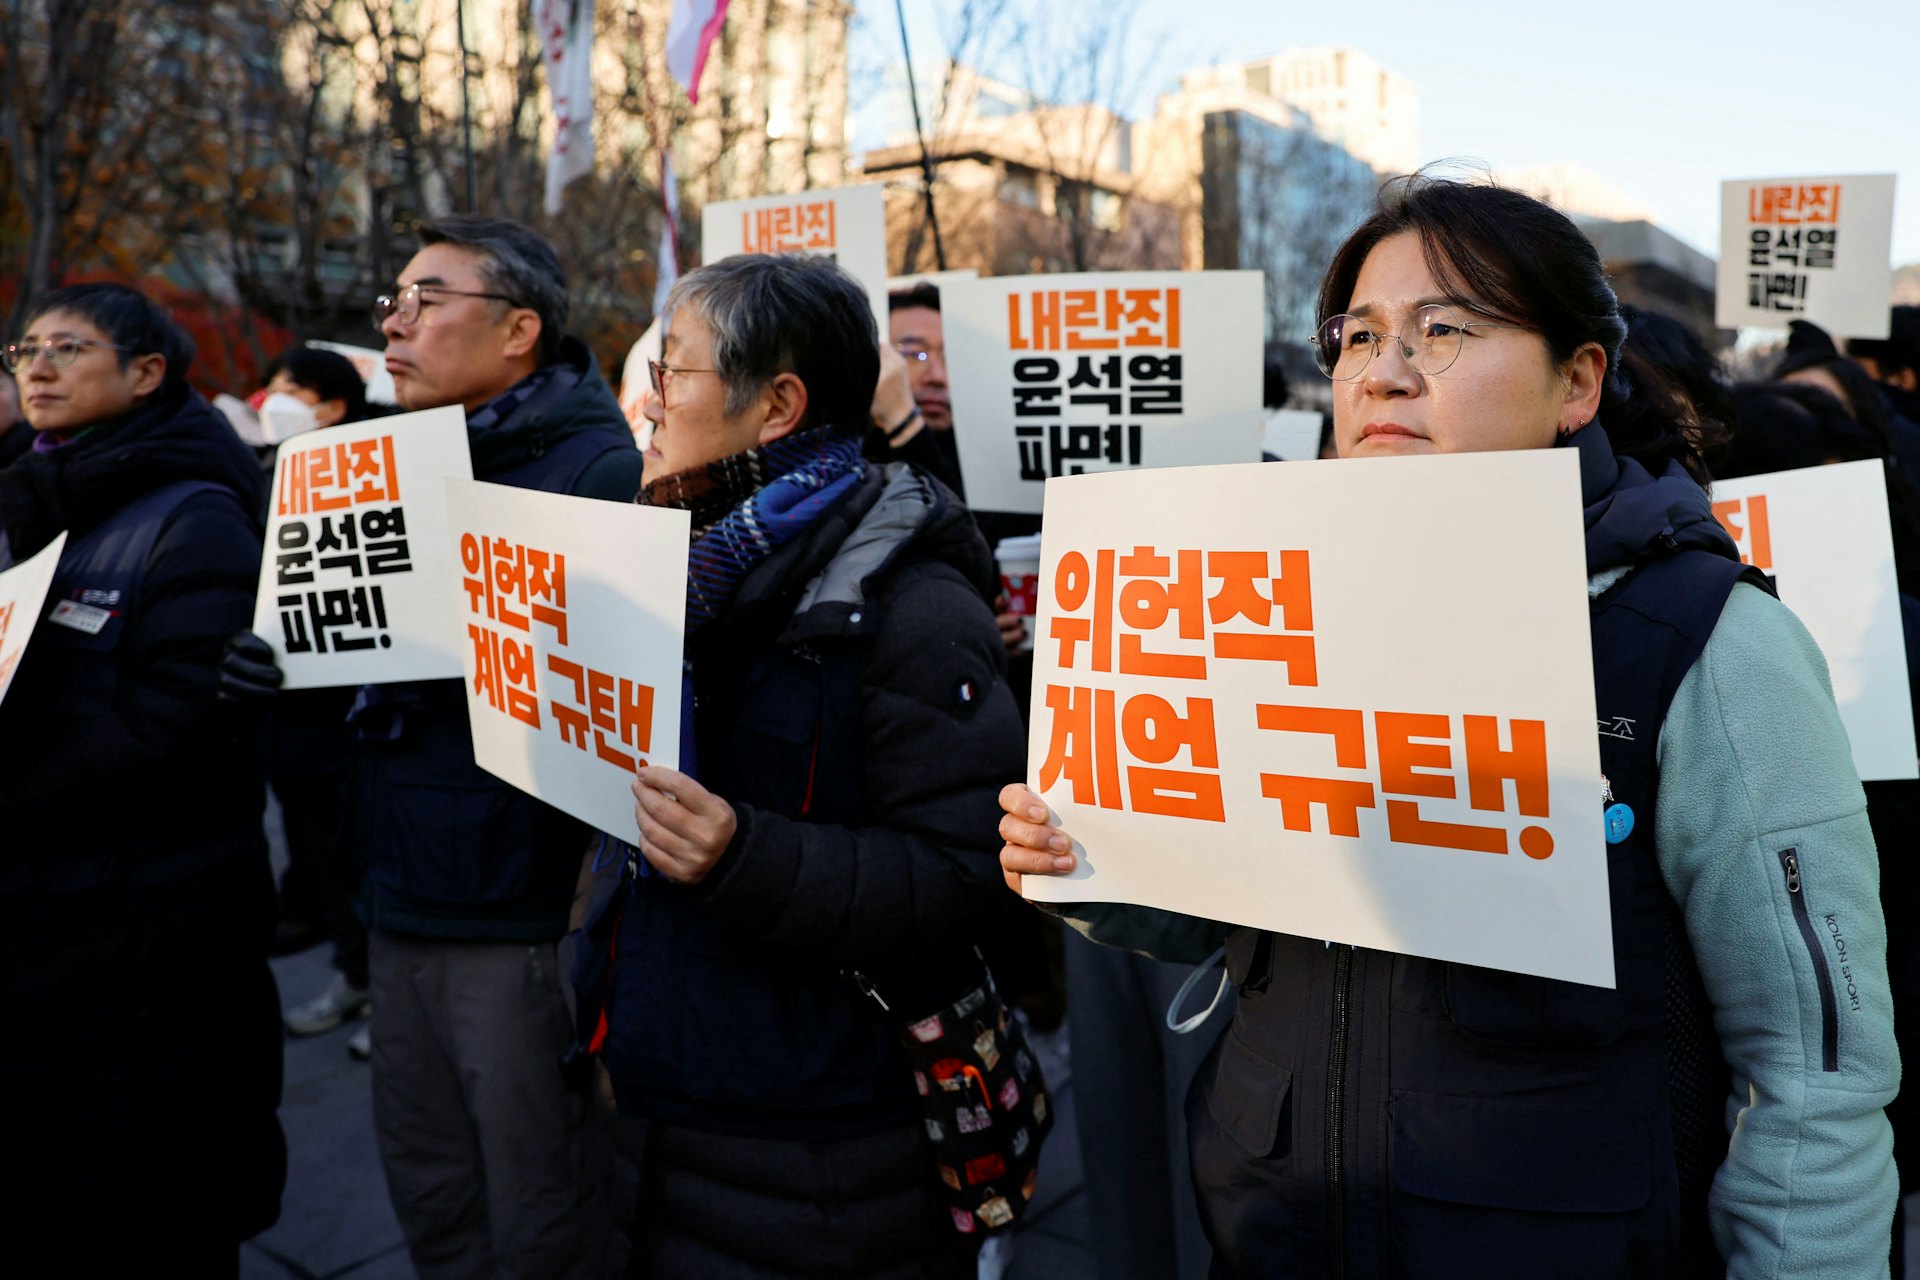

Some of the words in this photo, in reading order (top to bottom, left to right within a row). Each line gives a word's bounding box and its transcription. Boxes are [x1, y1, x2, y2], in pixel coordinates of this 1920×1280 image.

[741, 200, 836, 255] 내란죄
[1749, 184, 1841, 225] 내란죄
[1750, 229, 1837, 269] 윤석열
[1008, 288, 1181, 351] 내란죄
[1749, 273, 1807, 312] 파면!
[1013, 355, 1183, 416] 윤석열
[278, 435, 400, 516] 내란죄
[276, 506, 413, 586] 윤석열
[277, 585, 391, 654] 파면!
[461, 532, 568, 647] 위헌적
[1050, 546, 1318, 687] 위헌적
[467, 623, 541, 730] 계엄
[547, 653, 655, 774] 규탄!
[1039, 684, 1226, 823] 계엄
[1256, 703, 1554, 861] 규탄!
[1824, 913, 1848, 963] KOLON
[1842, 966, 1861, 1012] SPORT
